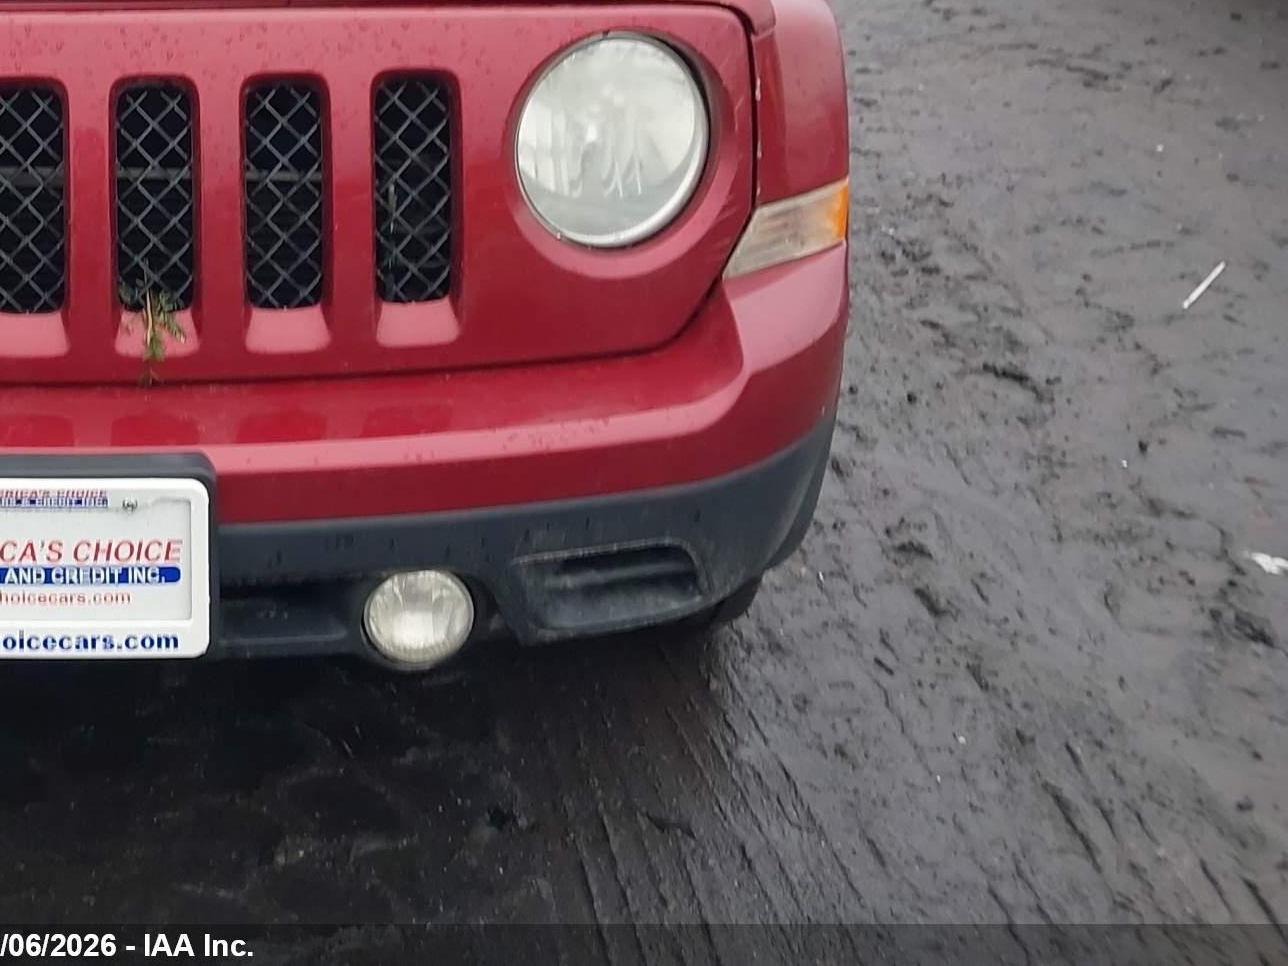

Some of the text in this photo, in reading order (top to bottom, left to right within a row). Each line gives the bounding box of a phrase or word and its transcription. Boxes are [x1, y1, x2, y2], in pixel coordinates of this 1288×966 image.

[73, 540, 184, 562] CHOICE
[5, 566, 45, 584] AND
[53, 566, 123, 584] CREDIT
[128, 566, 166, 584] INC.
